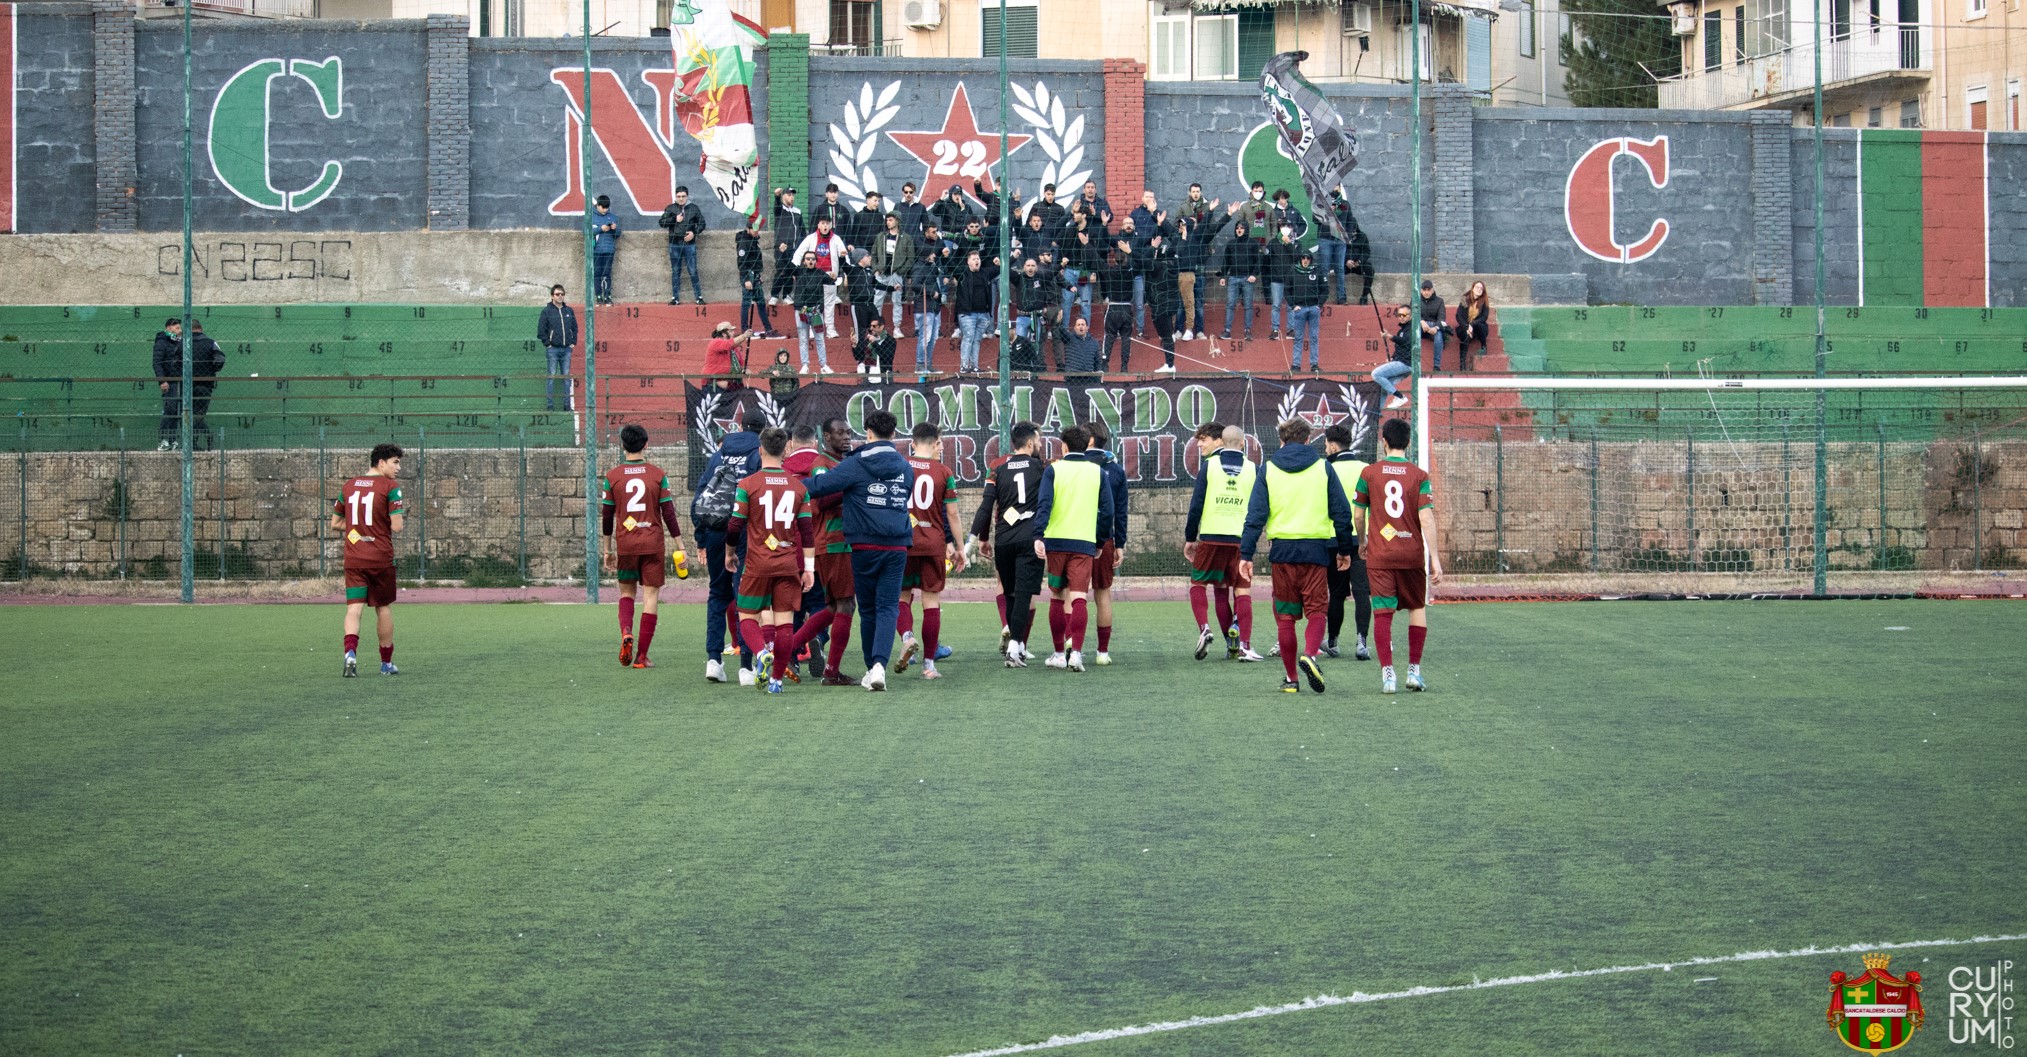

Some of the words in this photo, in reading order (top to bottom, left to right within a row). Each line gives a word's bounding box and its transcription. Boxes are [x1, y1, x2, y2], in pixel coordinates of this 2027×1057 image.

[207, 56, 343, 212] C
[548, 67, 677, 216] N
[933, 140, 987, 178] 22
[1565, 134, 1670, 265] C
[63, 306, 70, 318] 5
[134, 306, 140, 318] 6
[205, 306, 211, 318] 7
[413, 306, 425, 318] 10
[483, 306, 493, 318] 11
[627, 307, 639, 318] 13
[695, 307, 707, 318] 14
[838, 306, 849, 317] 16
[1574, 309, 1587, 321] 25
[1643, 308, 1655, 318] 26
[1711, 308, 1723, 318] 27
[1780, 308, 1792, 318] 28
[1846, 308, 1859, 319] 29
[1915, 308, 1928, 319] 30
[1981, 308, 1993, 320] 31
[23, 343, 36, 354] 41
[94, 343, 107, 355] 42
[237, 343, 251, 355] 44
[309, 343, 323, 354] 45
[379, 341, 392, 353] 46
[452, 341, 465, 352] 47
[522, 340, 536, 352] 48
[666, 341, 680, 352] 50
[1230, 341, 1243, 352] 58
[1365, 340, 1378, 351] 60
[1612, 341, 1625, 352] 62
[1682, 341, 1696, 352] 63
[1887, 341, 1900, 353] 66
[1955, 341, 1968, 353] 67
[846, 384, 1217, 438] COMMANDO
[19, 418, 38, 429] 114
[532, 415, 549, 426] 121
[1312, 414, 1334, 430] 22
[1013, 472, 1026, 504] 1
[625, 478, 646, 513] 2
[1215, 497, 1244, 506] VICARI
[1384, 479, 1405, 518] 8
[348, 490, 375, 527] 11
[758, 489, 796, 530] 14
